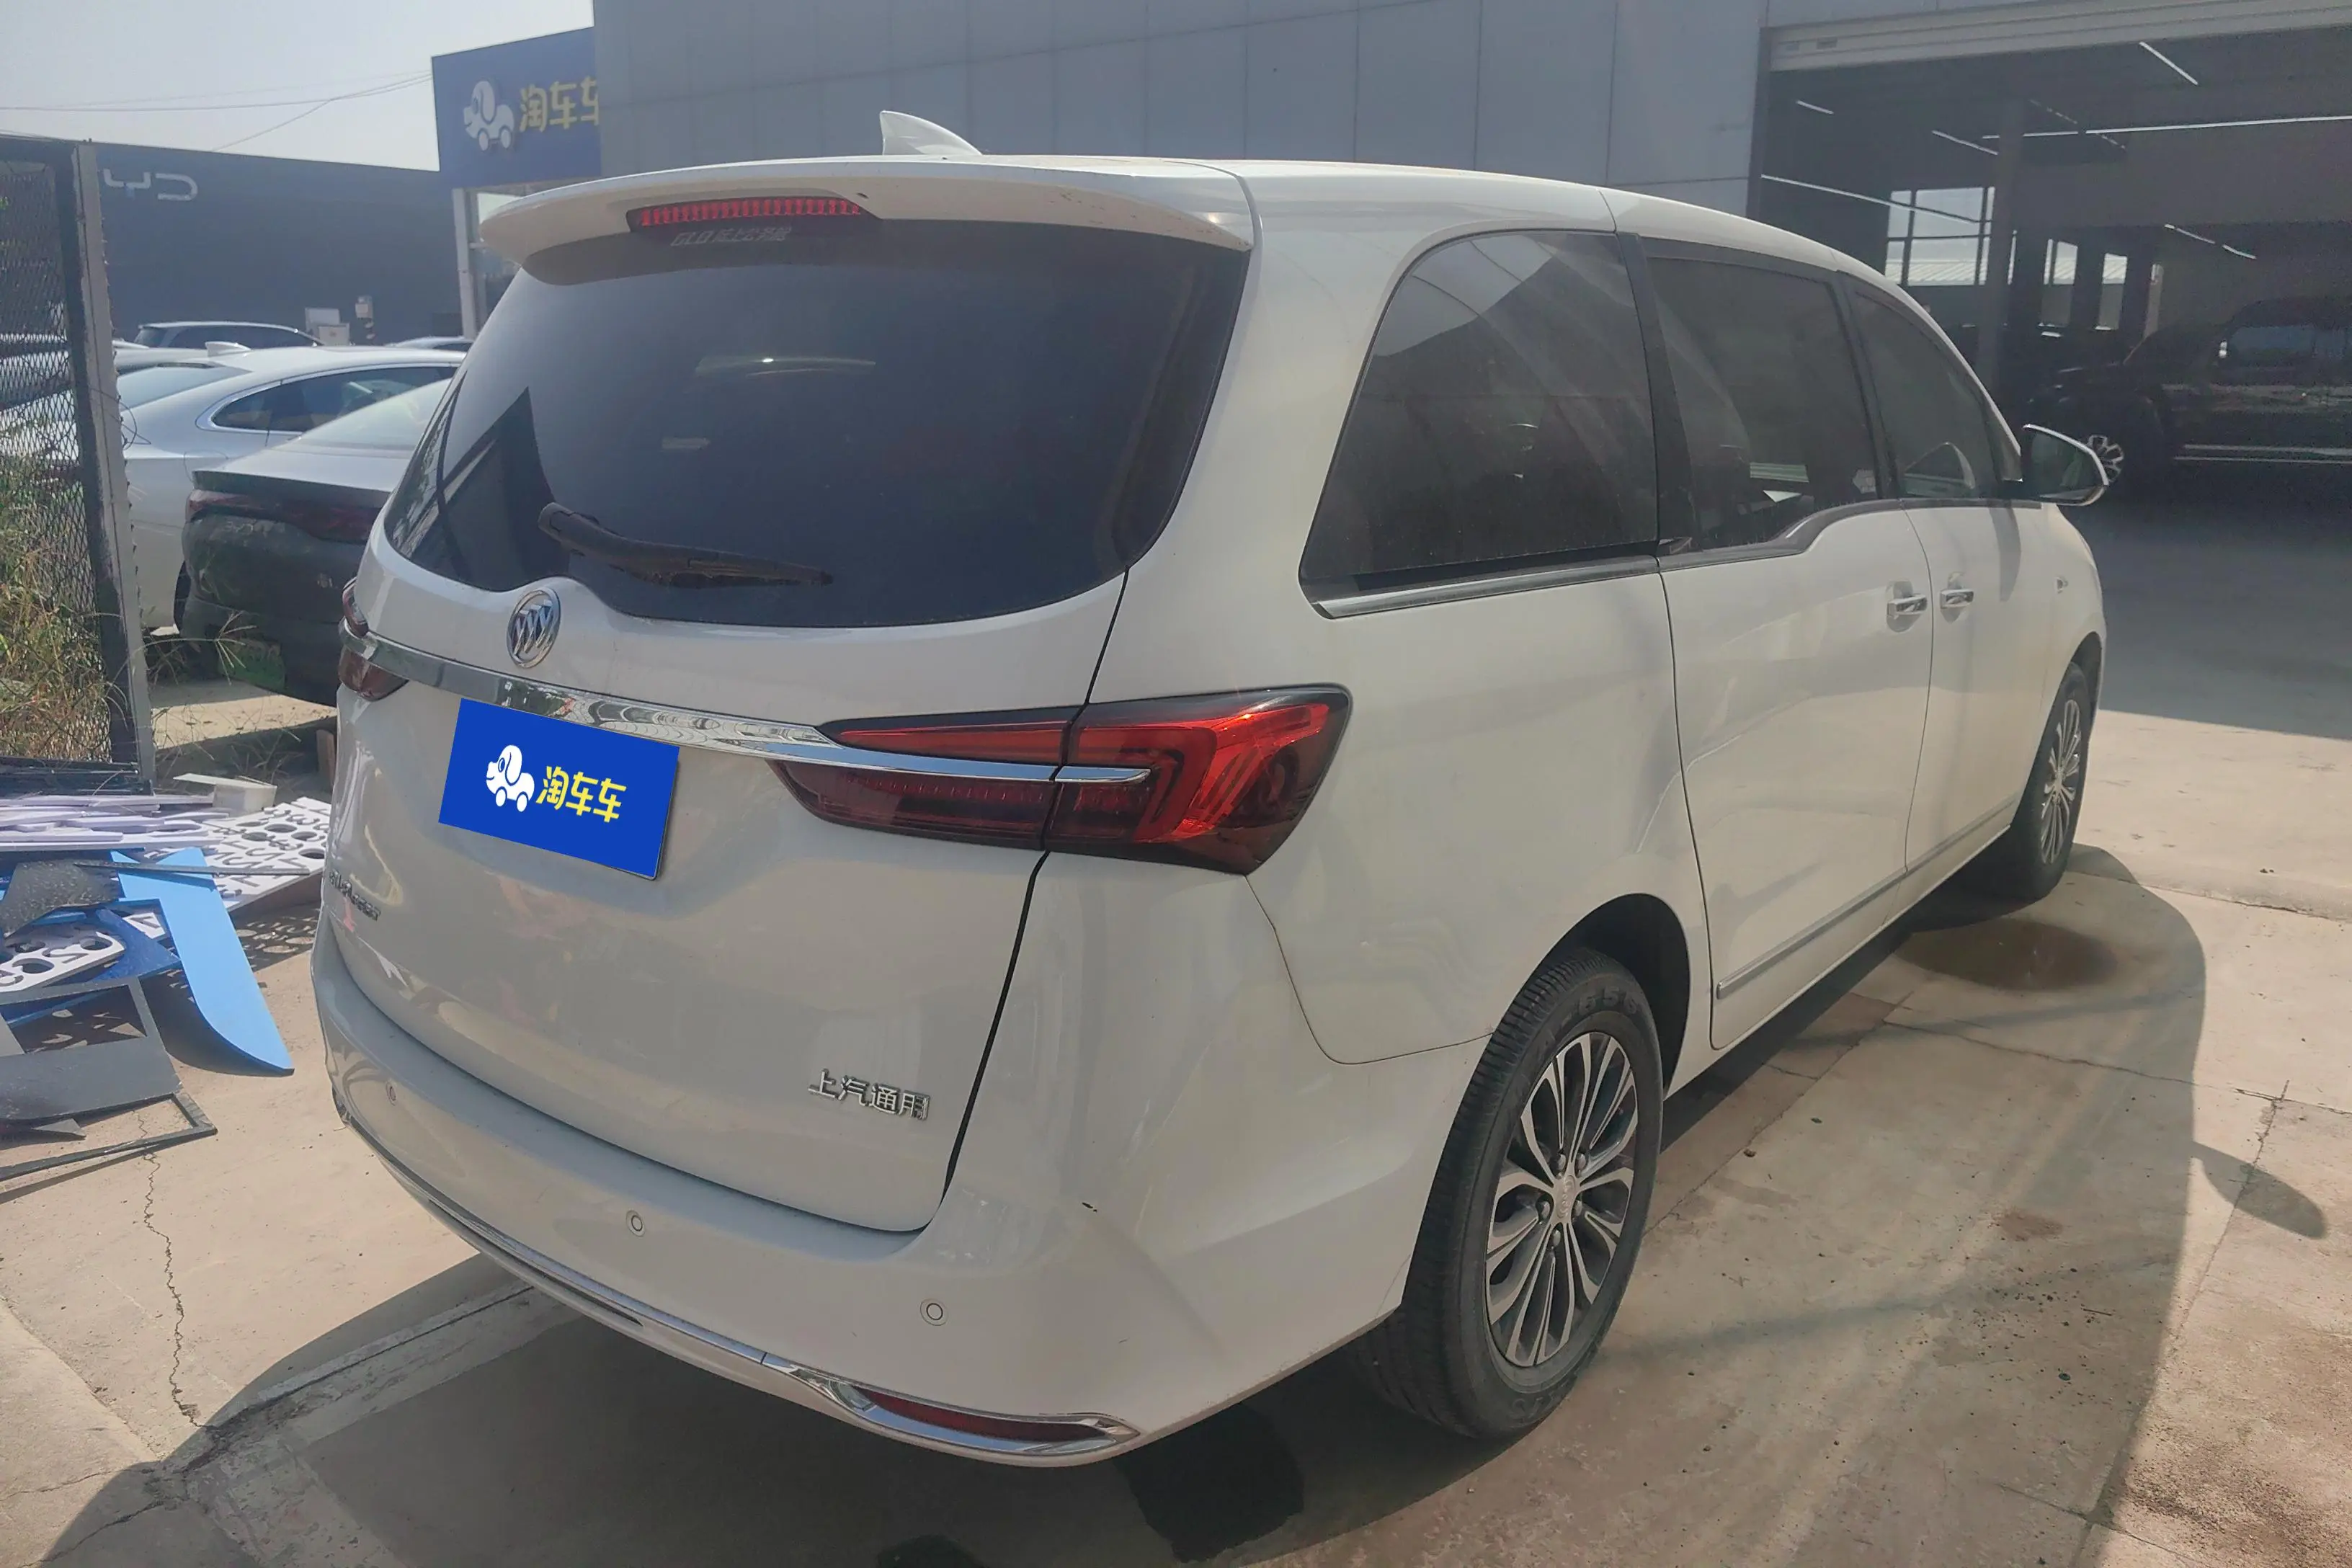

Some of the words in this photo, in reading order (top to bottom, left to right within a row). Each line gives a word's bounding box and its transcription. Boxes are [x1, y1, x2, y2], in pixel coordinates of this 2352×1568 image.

[520, 76, 600, 132] 淘车车
[103, 168, 198, 201] YD
[808, 1069, 930, 1121] 上汽通用
